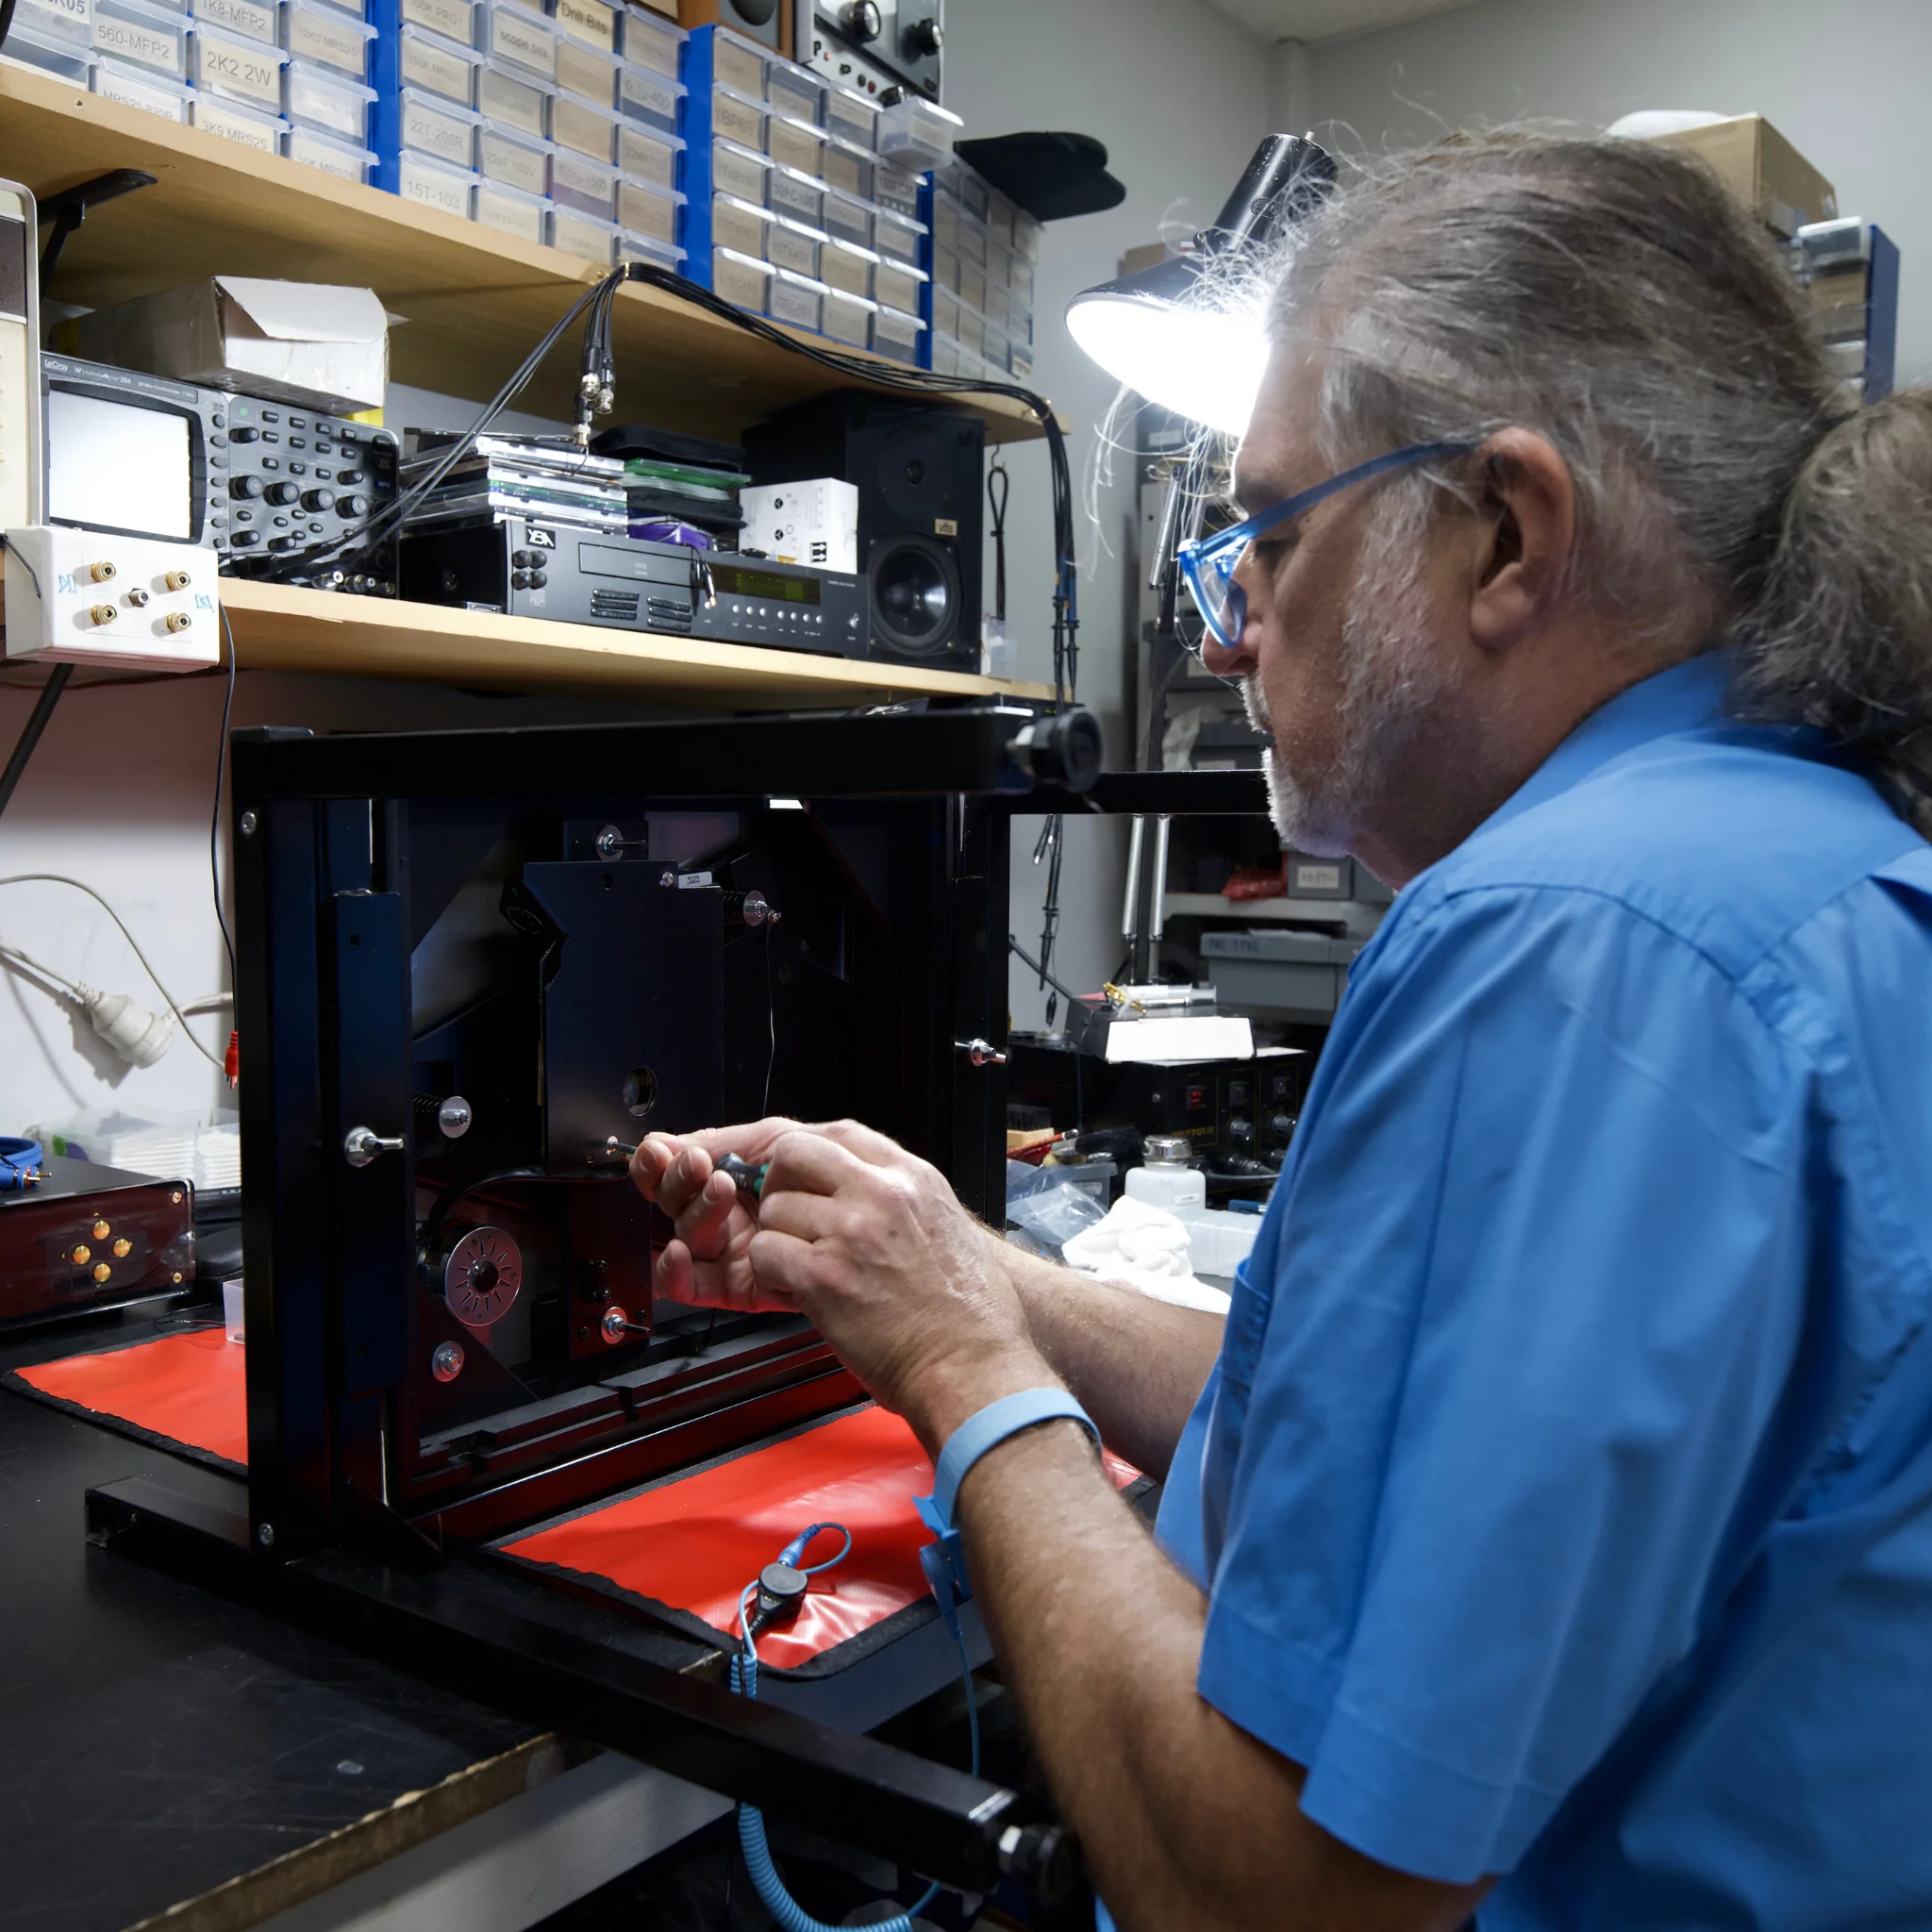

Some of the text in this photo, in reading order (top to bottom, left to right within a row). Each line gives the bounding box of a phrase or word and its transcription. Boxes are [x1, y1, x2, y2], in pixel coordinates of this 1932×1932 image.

[561, 2, 608, 35] Drill Bits
[98, 25, 170, 59] 560-MFP2
[500, 30, 548, 59] scope bits
[208, 51, 272, 87] 2K2 2W
[202, 121, 268, 150] 3K9 MRS25
[410, 119, 463, 150] 22T-200R
[408, 181, 459, 208] 15T-103
[44, 358, 69, 373] LeCroy
[527, 528, 555, 547] YBA
